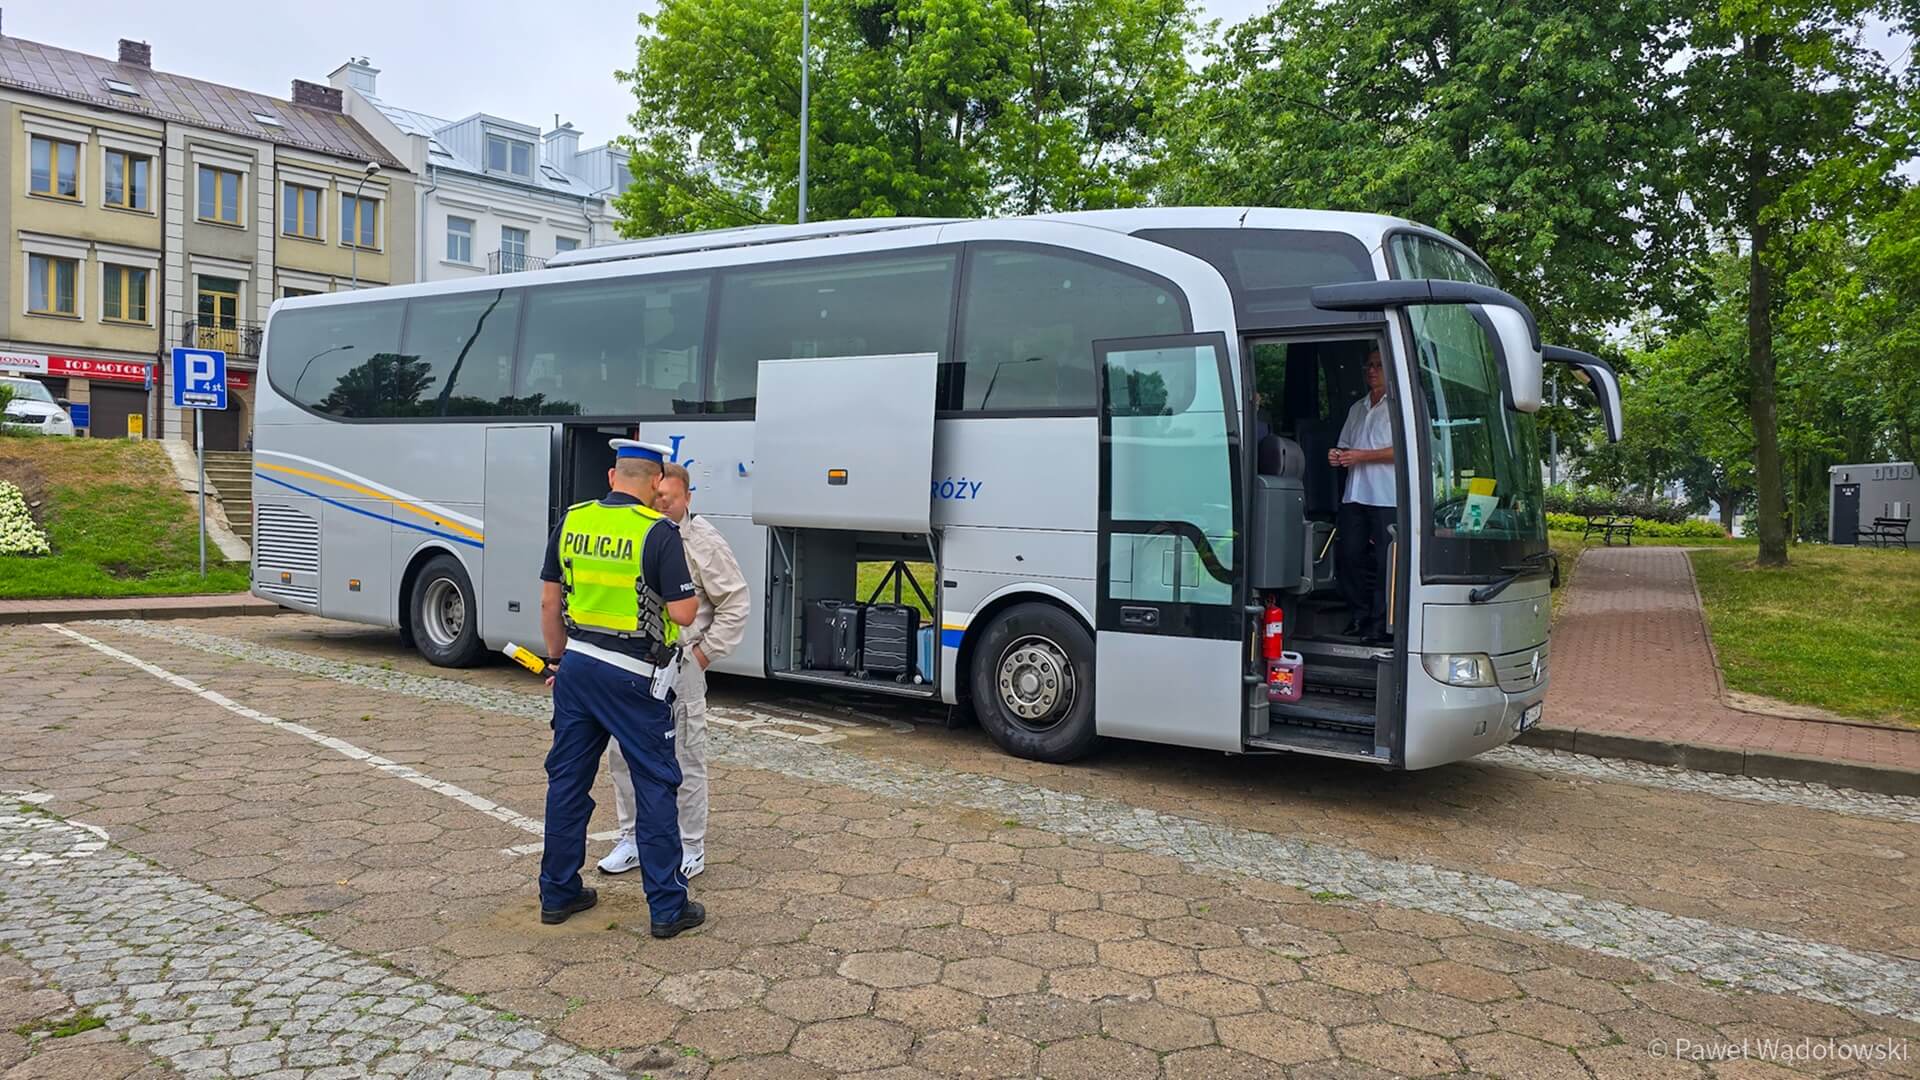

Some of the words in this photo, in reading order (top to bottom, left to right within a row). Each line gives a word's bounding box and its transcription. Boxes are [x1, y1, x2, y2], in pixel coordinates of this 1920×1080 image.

[64, 359, 92, 370] TOP
[185, 354, 215, 390] P
[203, 382, 211, 391] 4
[564, 532, 633, 561] POLICJA
